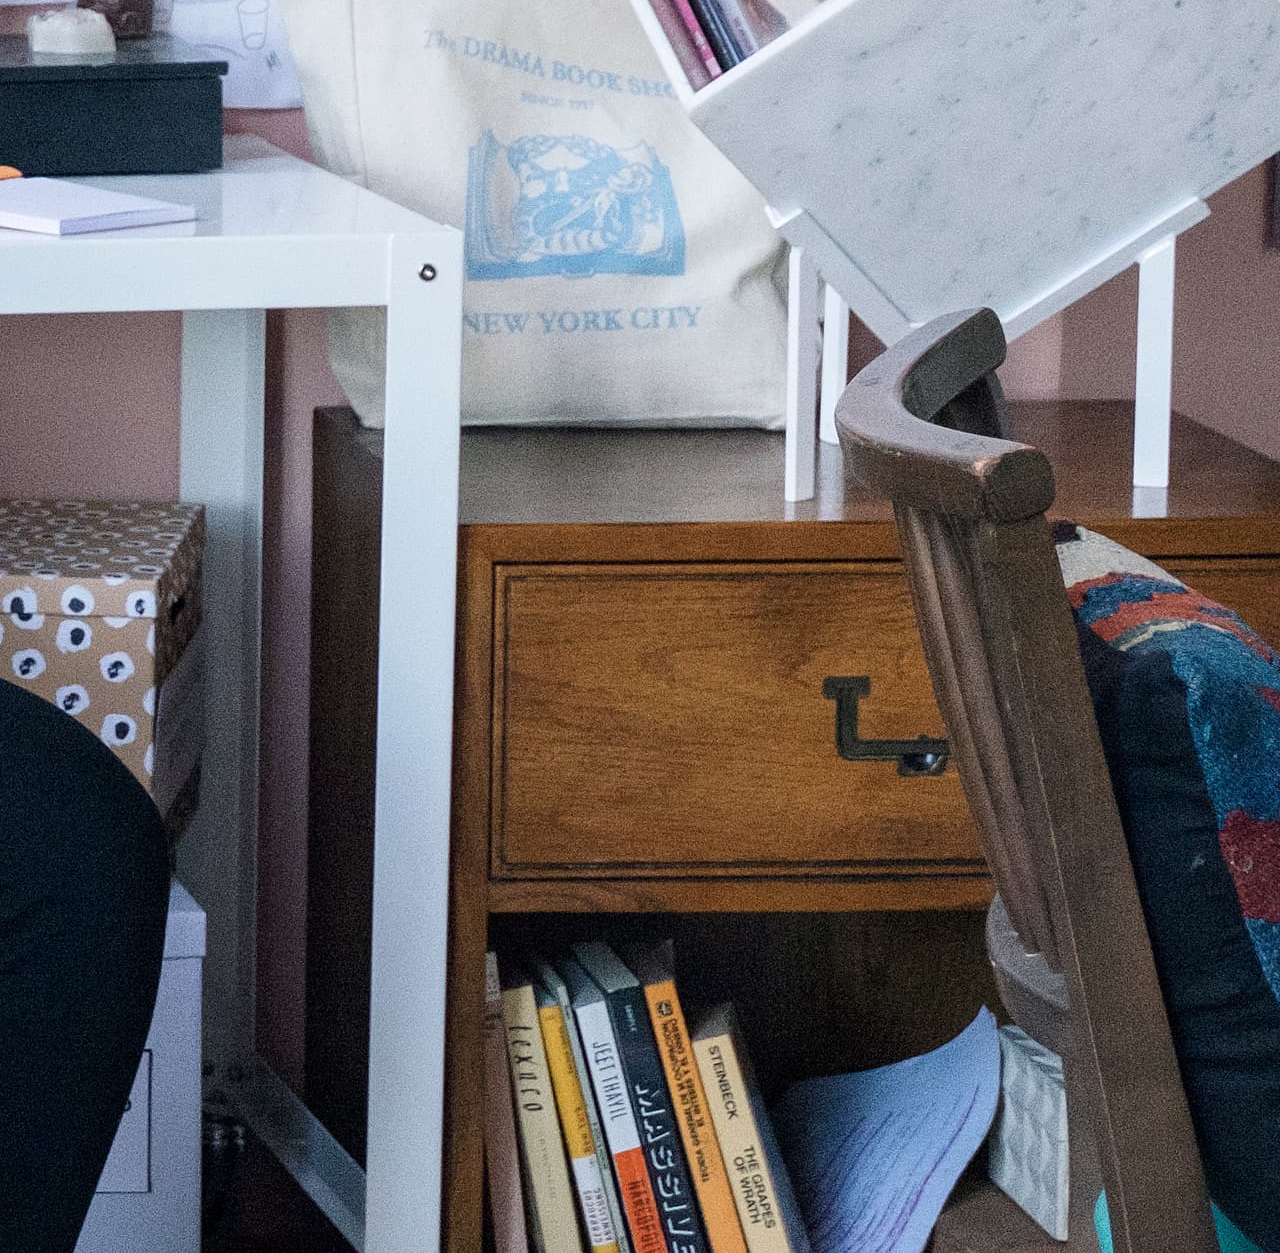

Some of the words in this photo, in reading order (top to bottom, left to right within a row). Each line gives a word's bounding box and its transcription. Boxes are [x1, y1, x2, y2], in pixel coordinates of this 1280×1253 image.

[462, 34, 545, 79] DRAMA
[551, 59, 626, 93] BOOK
[627, 75, 677, 99] SHO
[463, 311, 530, 336] NEW
[537, 308, 625, 335] YORK
[630, 305, 703, 330] CITY
[592, 1041, 616, 1072] JEET
[602, 1076, 628, 1121] THAYIL
[708, 1044, 739, 1121] STEINBECK
[733, 1156, 746, 1173] OF
[742, 1145, 759, 1171] THE
[739, 1176, 760, 1225] WRATH
[750, 1173, 777, 1229] GRAPES
